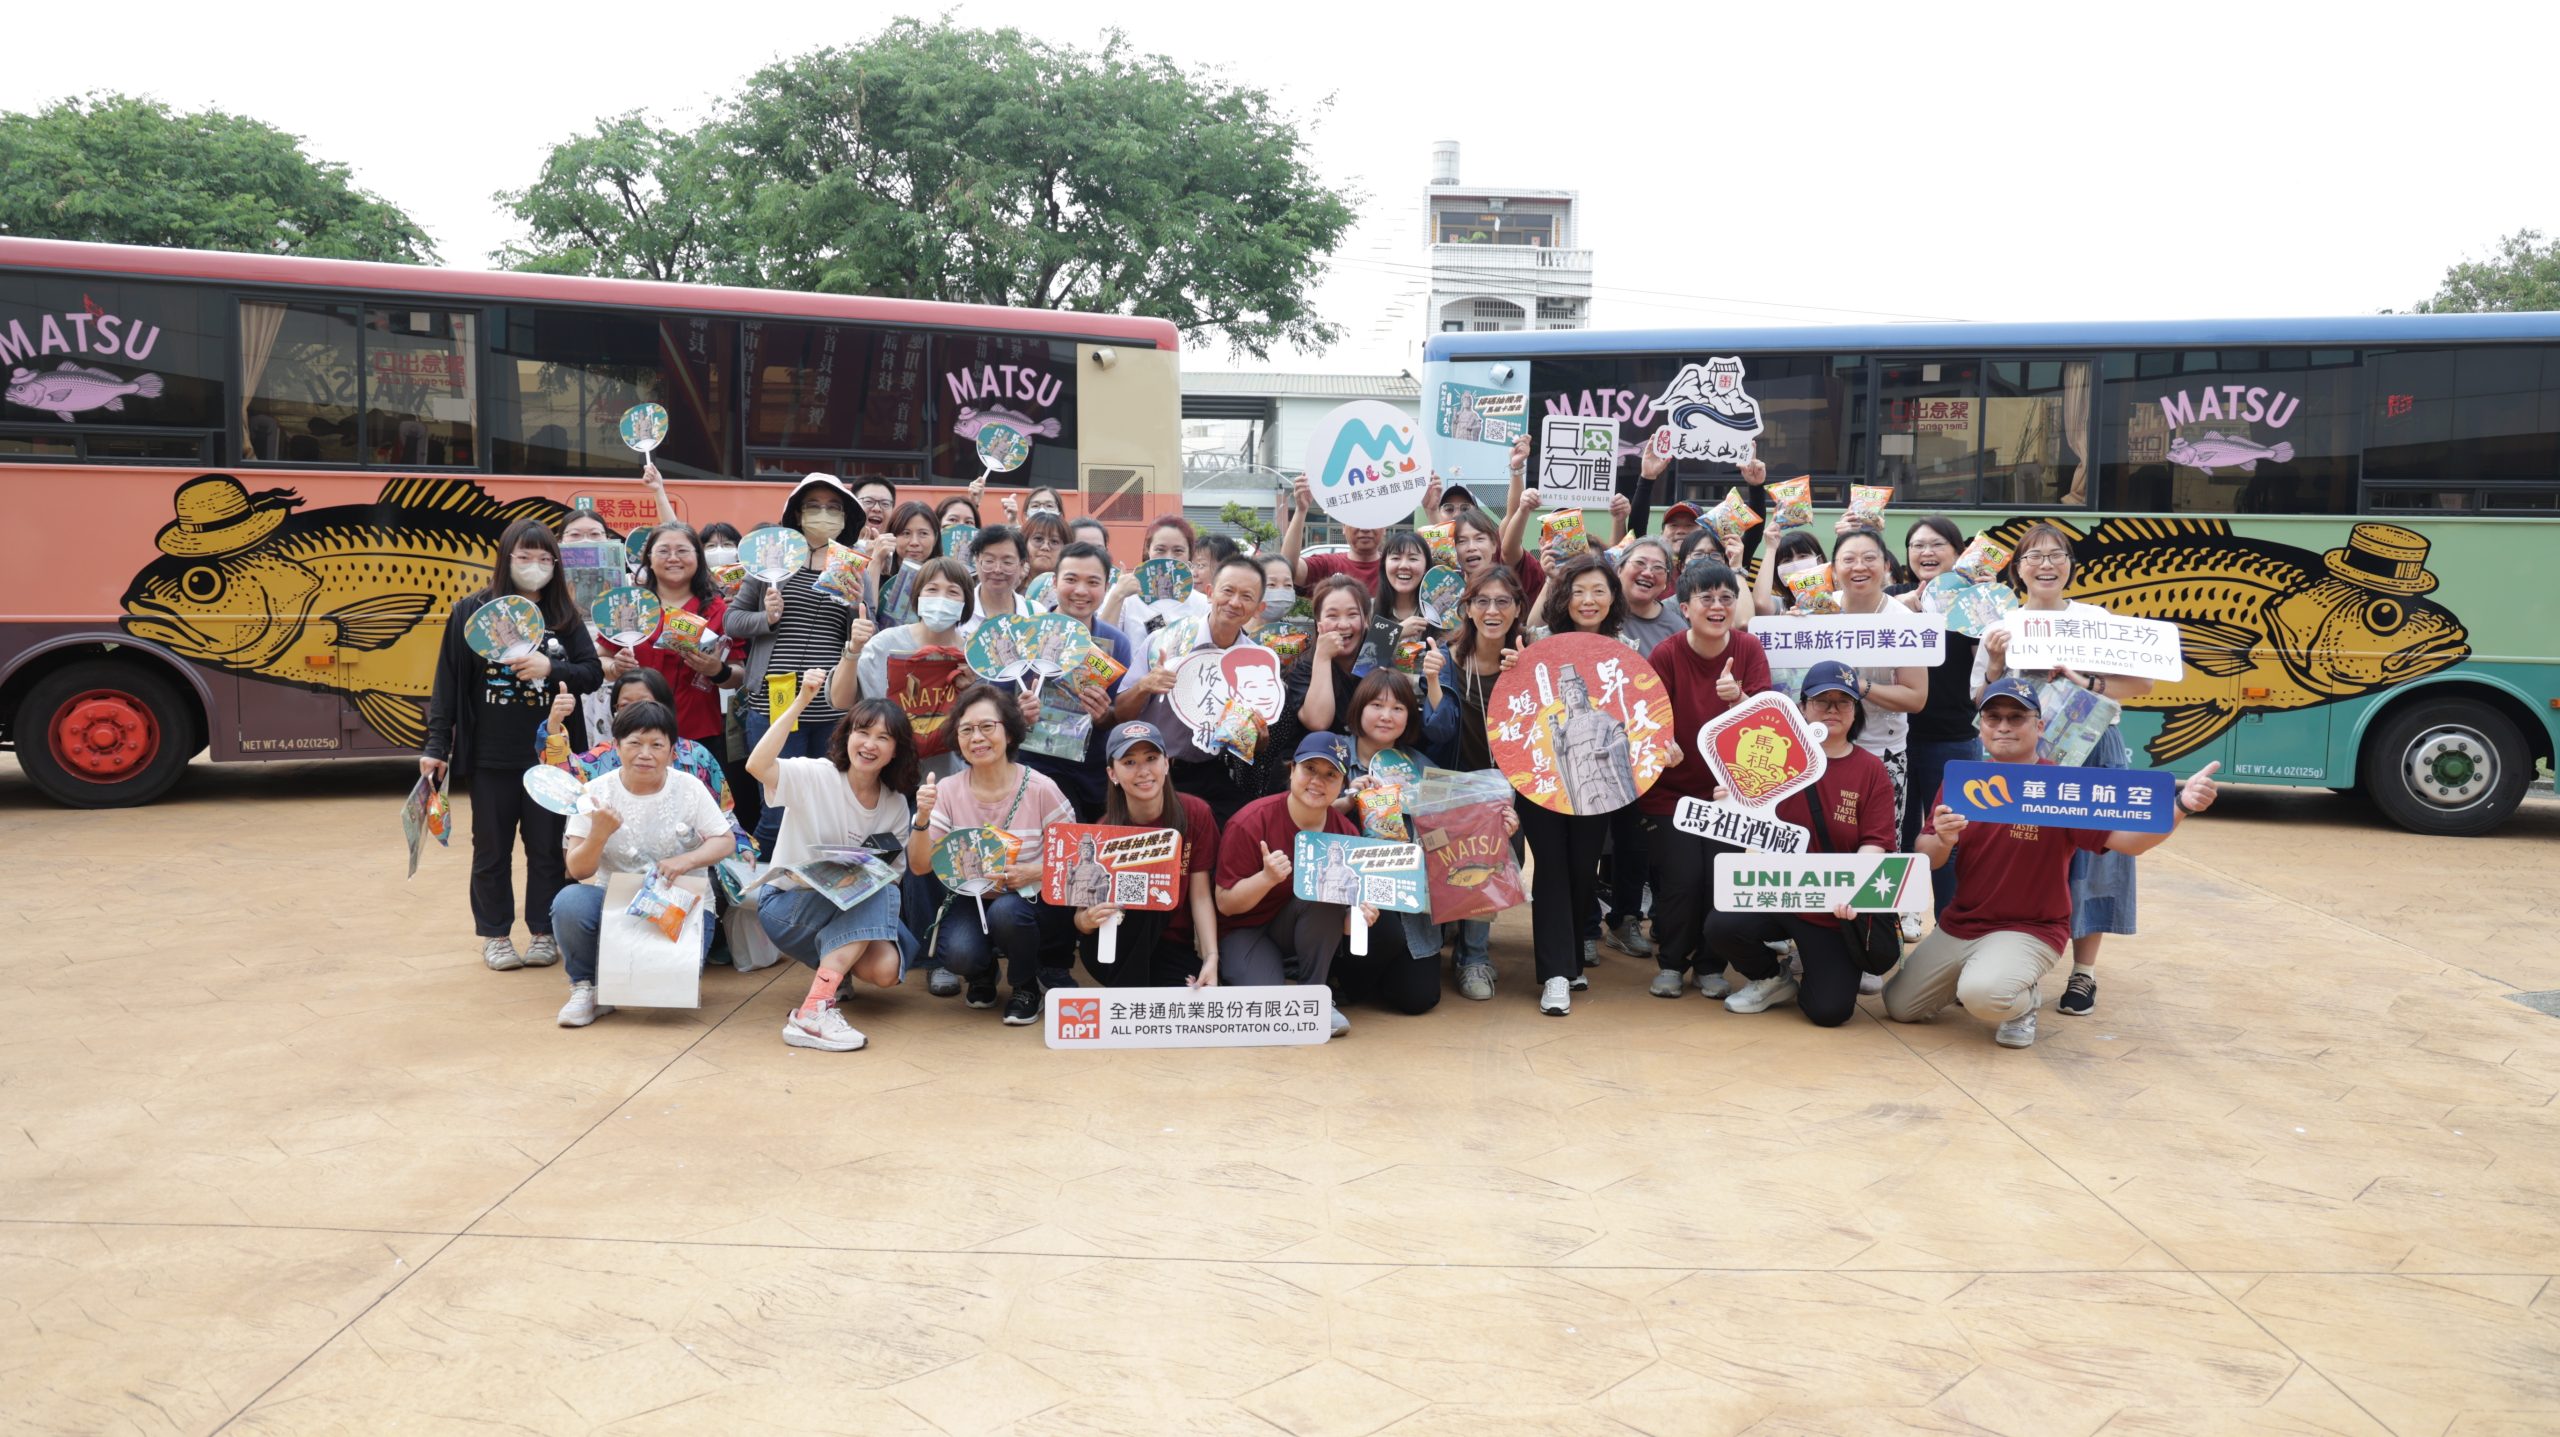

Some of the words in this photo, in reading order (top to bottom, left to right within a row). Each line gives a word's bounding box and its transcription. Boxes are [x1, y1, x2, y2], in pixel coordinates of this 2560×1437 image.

[0, 313, 160, 366] MATSU
[946, 365, 1063, 407] MATSU
[2160, 385, 2300, 430] MATSU
[1325, 476, 1427, 508] 連江縣交通旅遊局
[606, 521, 653, 529] mergency
[1755, 628, 1939, 651] 連江縣旅行同業公會
[2011, 644, 2038, 655] LIN
[2046, 645, 2086, 657] YIHE
[2094, 647, 2175, 666] FACTORY
[2089, 658, 2134, 669] HANDMADE
[899, 685, 955, 711] MATU
[1597, 658, 1663, 778] 昇天祭
[243, 740, 261, 750] NET
[263, 740, 277, 749] WT
[296, 738, 339, 749] OZ(125g)
[1747, 734, 1774, 770] 馬祖
[2235, 764, 2251, 774] NET
[2253, 765, 2267, 775] WT
[2283, 766, 2324, 779] OZ(125g)
[2022, 780, 2152, 806] 華信航空
[1833, 812, 1847, 823] THE
[2021, 803, 2088, 817] MANDARIN
[2093, 808, 2152, 820] AIRLINES
[1680, 801, 1802, 854] 馬祖酒廠
[2009, 829, 2024, 839] THE
[2023, 831, 2039, 841] SEA
[1436, 835, 1502, 867] MATSU
[1733, 870, 1792, 887] UNI
[1798, 871, 1856, 887] AIR
[1733, 891, 1826, 908] 立榮航空
[1110, 999, 1320, 1020] 全港通航業股份有限公司
[1062, 1023, 1097, 1039] APT
[1111, 1024, 1132, 1035] ALL
[1134, 1024, 1173, 1035] PORTS
[1175, 1023, 1270, 1035] TRANSPORTATON
[1273, 1022, 1295, 1034] CO.,
[1297, 1021, 1319, 1032] LTD.
